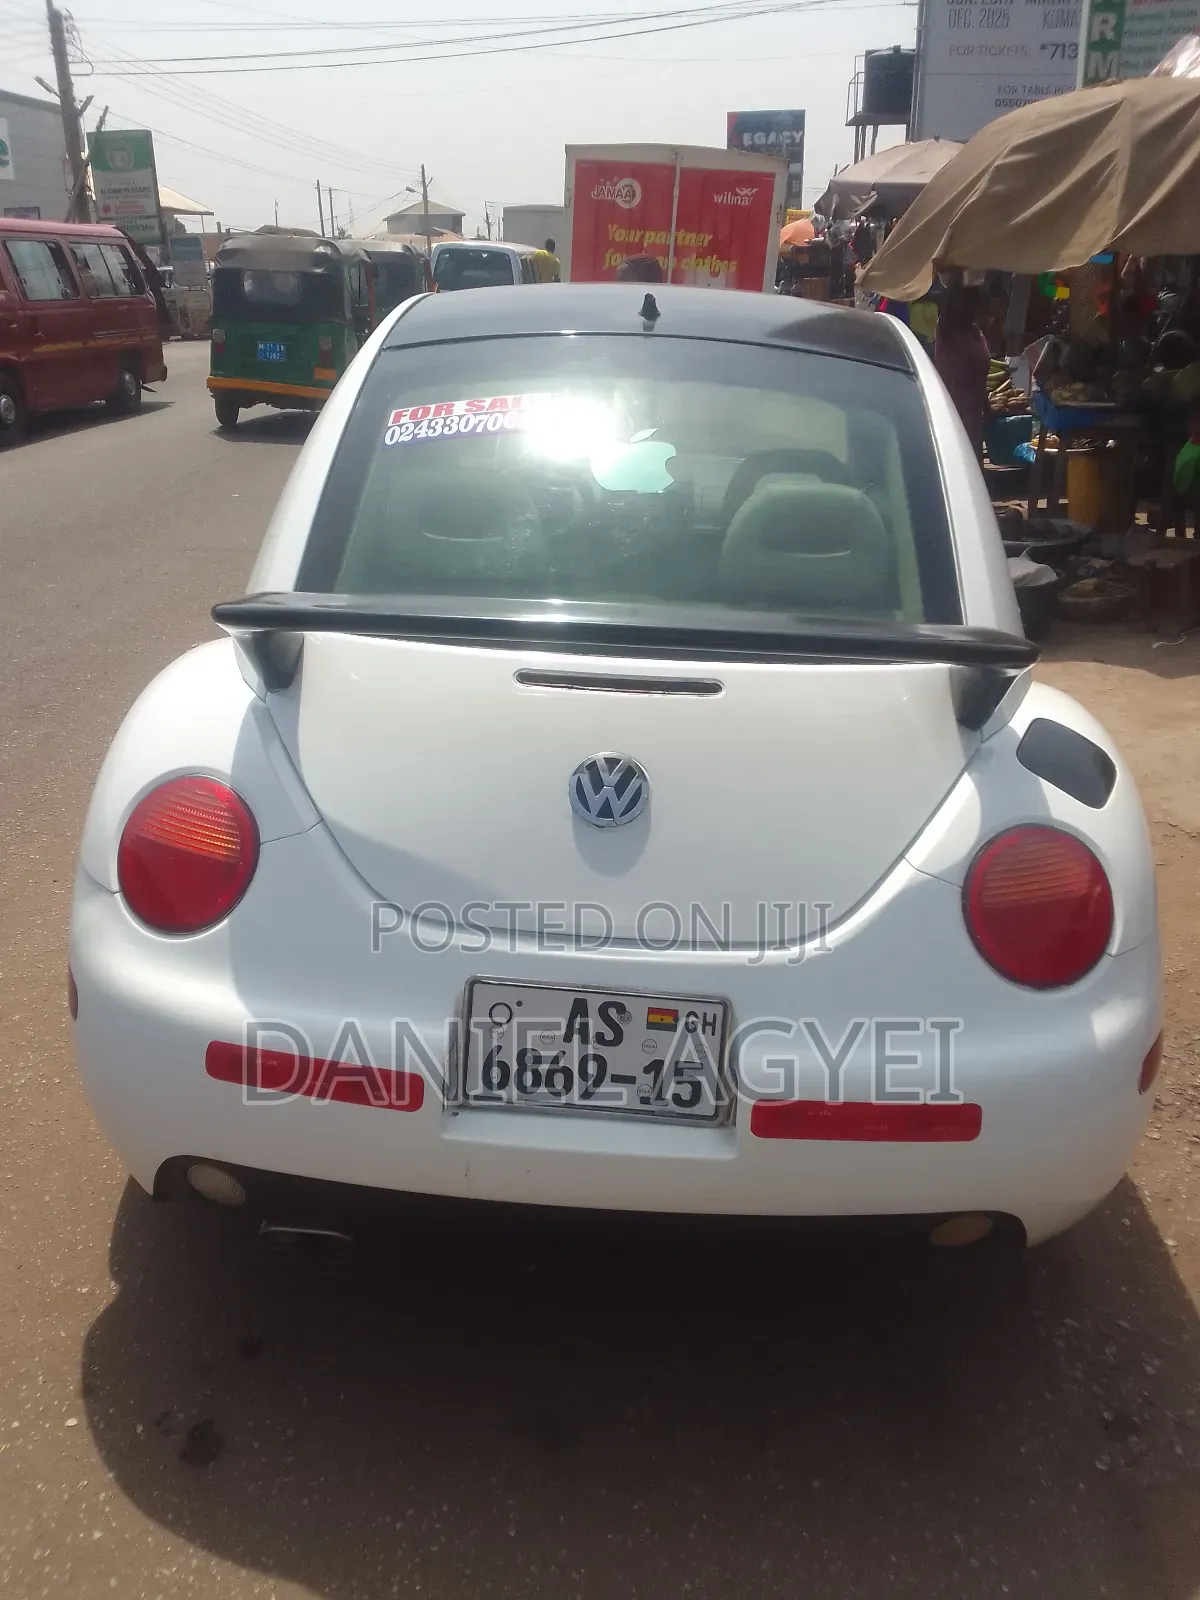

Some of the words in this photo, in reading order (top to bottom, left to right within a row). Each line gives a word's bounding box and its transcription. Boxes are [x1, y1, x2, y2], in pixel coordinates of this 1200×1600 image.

[948, 8, 975, 29] DEC.
[979, 8, 1010, 29] 2025
[949, 44, 975, 57] FOR
[591, 184, 632, 200] JAMAA
[713, 191, 754, 206] wilmar
[608, 223, 643, 243] Your
[680, 252, 738, 274] clothes
[391, 402, 456, 425] FOR
[464, 395, 525, 414] SAL
[563, 997, 626, 1047] AS
[684, 1010, 717, 1037] GH
[482, 1044, 703, 1108] 6869-15
